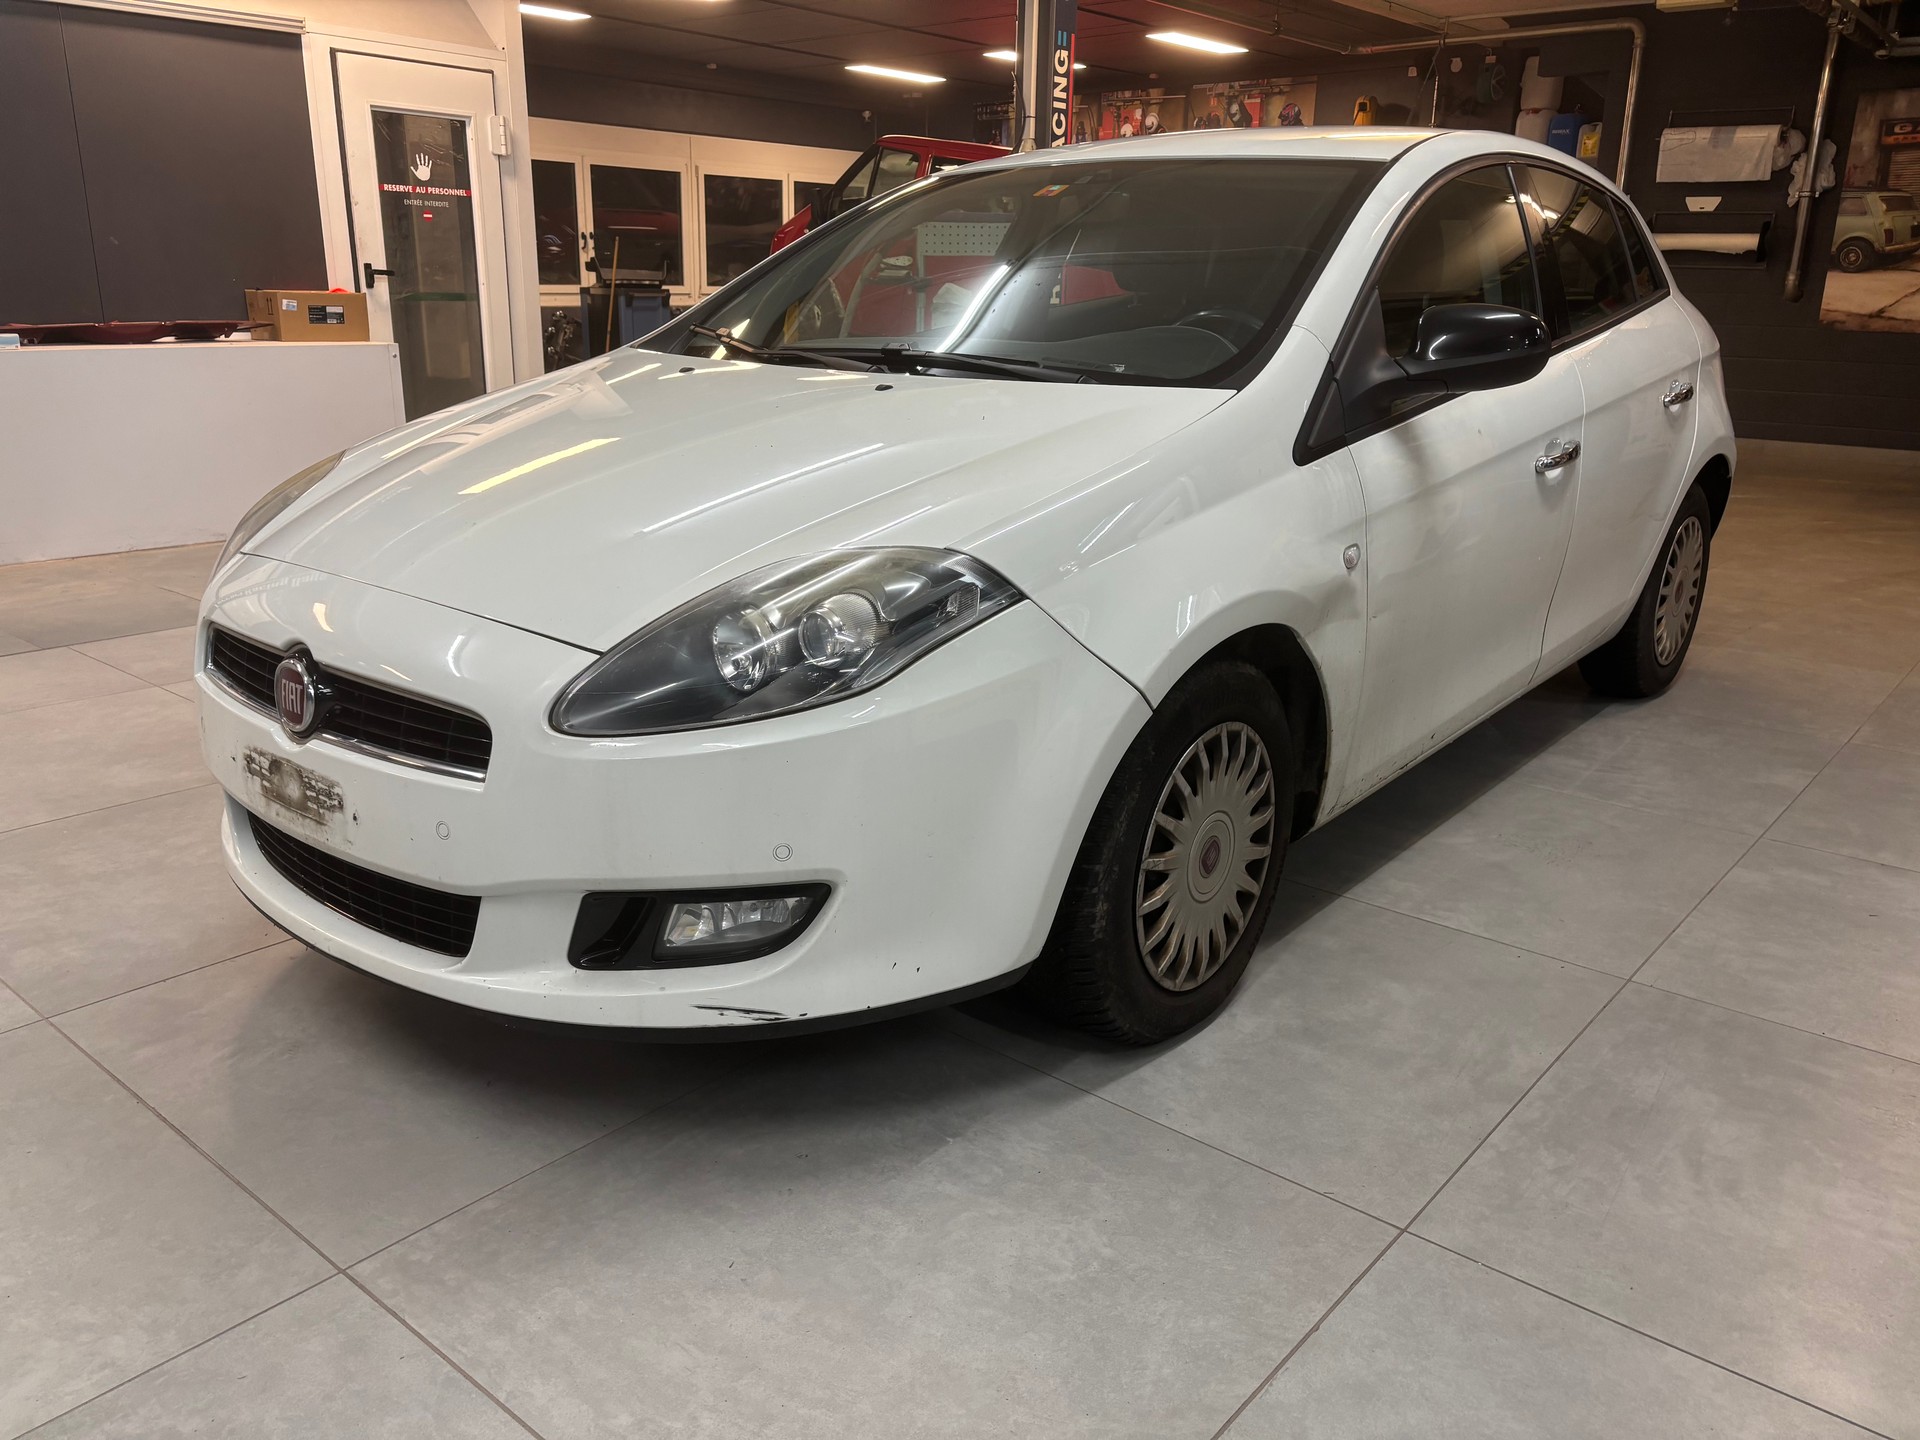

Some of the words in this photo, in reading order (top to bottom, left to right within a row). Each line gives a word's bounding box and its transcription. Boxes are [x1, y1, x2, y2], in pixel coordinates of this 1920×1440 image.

[383, 184, 412, 193] RESERVE
[428, 187, 467, 196] PERSONNEL
[404, 199, 422, 207] ENTRÉE
[424, 200, 449, 208] INTERDITE
[281, 678, 303, 714] FIAT
